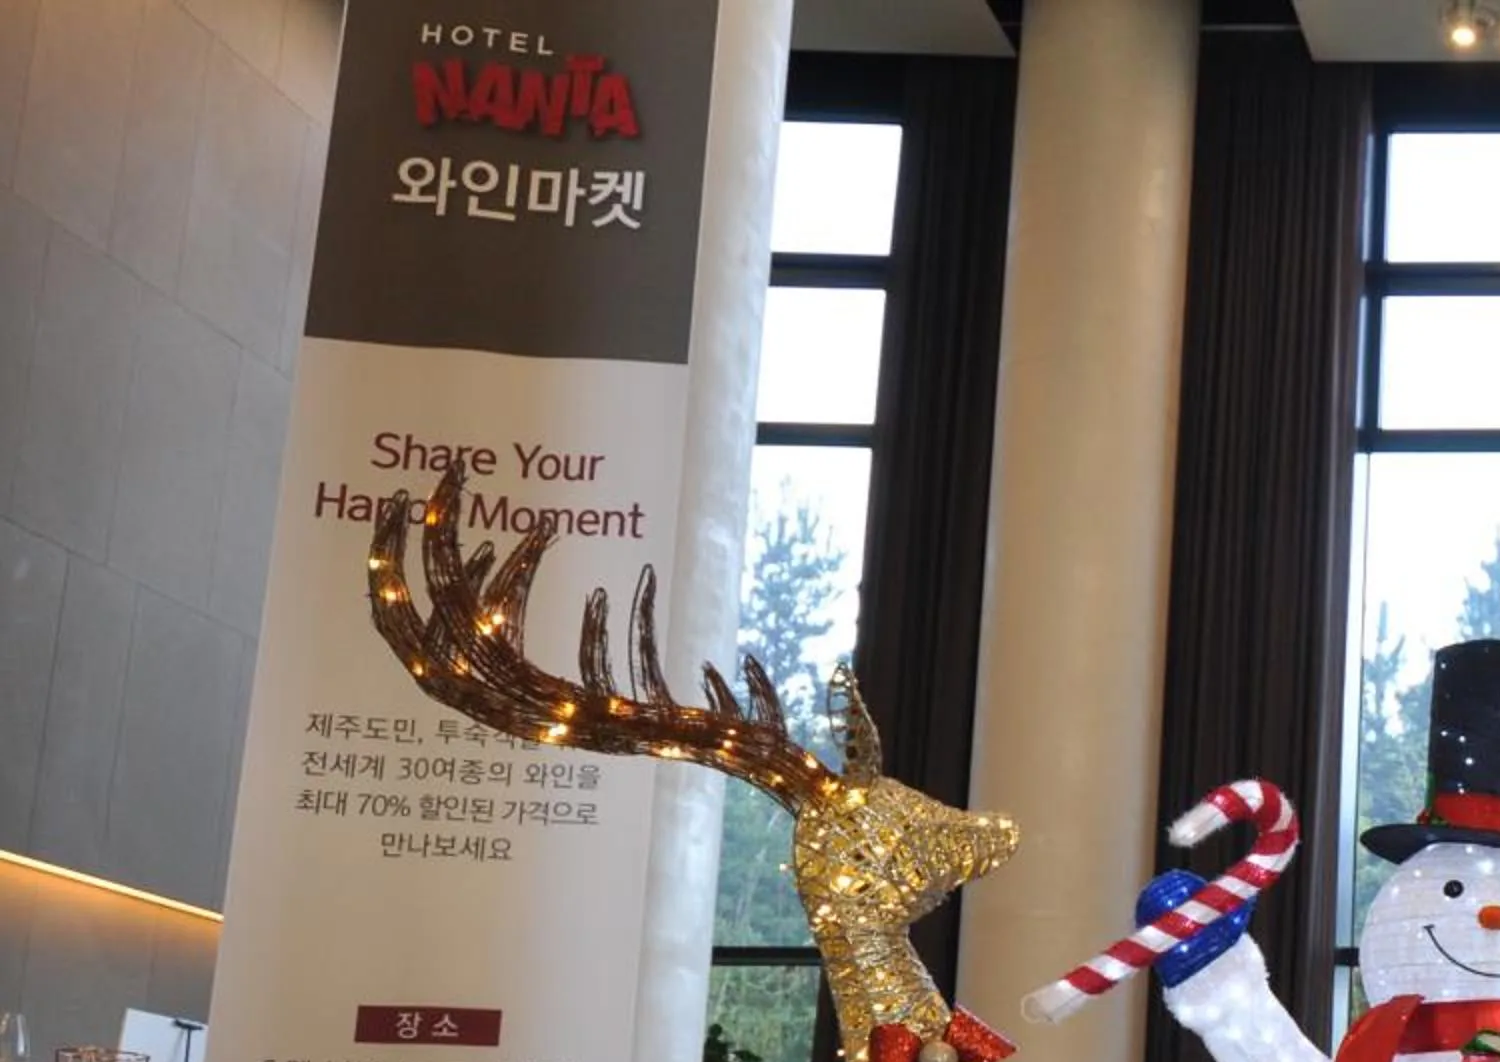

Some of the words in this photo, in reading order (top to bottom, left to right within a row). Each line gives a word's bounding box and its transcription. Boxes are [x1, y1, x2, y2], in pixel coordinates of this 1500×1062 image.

[420, 23, 554, 56] HOTEL
[412, 55, 642, 139] NANTA
[392, 156, 645, 230] 와인마켓
[371, 432, 498, 475] Share
[513, 443, 605, 482] Your
[468, 493, 645, 539] Moment
[305, 713, 424, 744] 제주도민,
[301, 751, 385, 780] 전세계
[397, 757, 513, 787] 30여종의
[523, 762, 602, 791] 와인을
[295, 788, 348, 817] 최대
[356, 793, 412, 818] 70%
[418, 794, 495, 823] 할인된
[501, 800, 600, 826] 가격으로
[381, 831, 514, 862] 만나보세요
